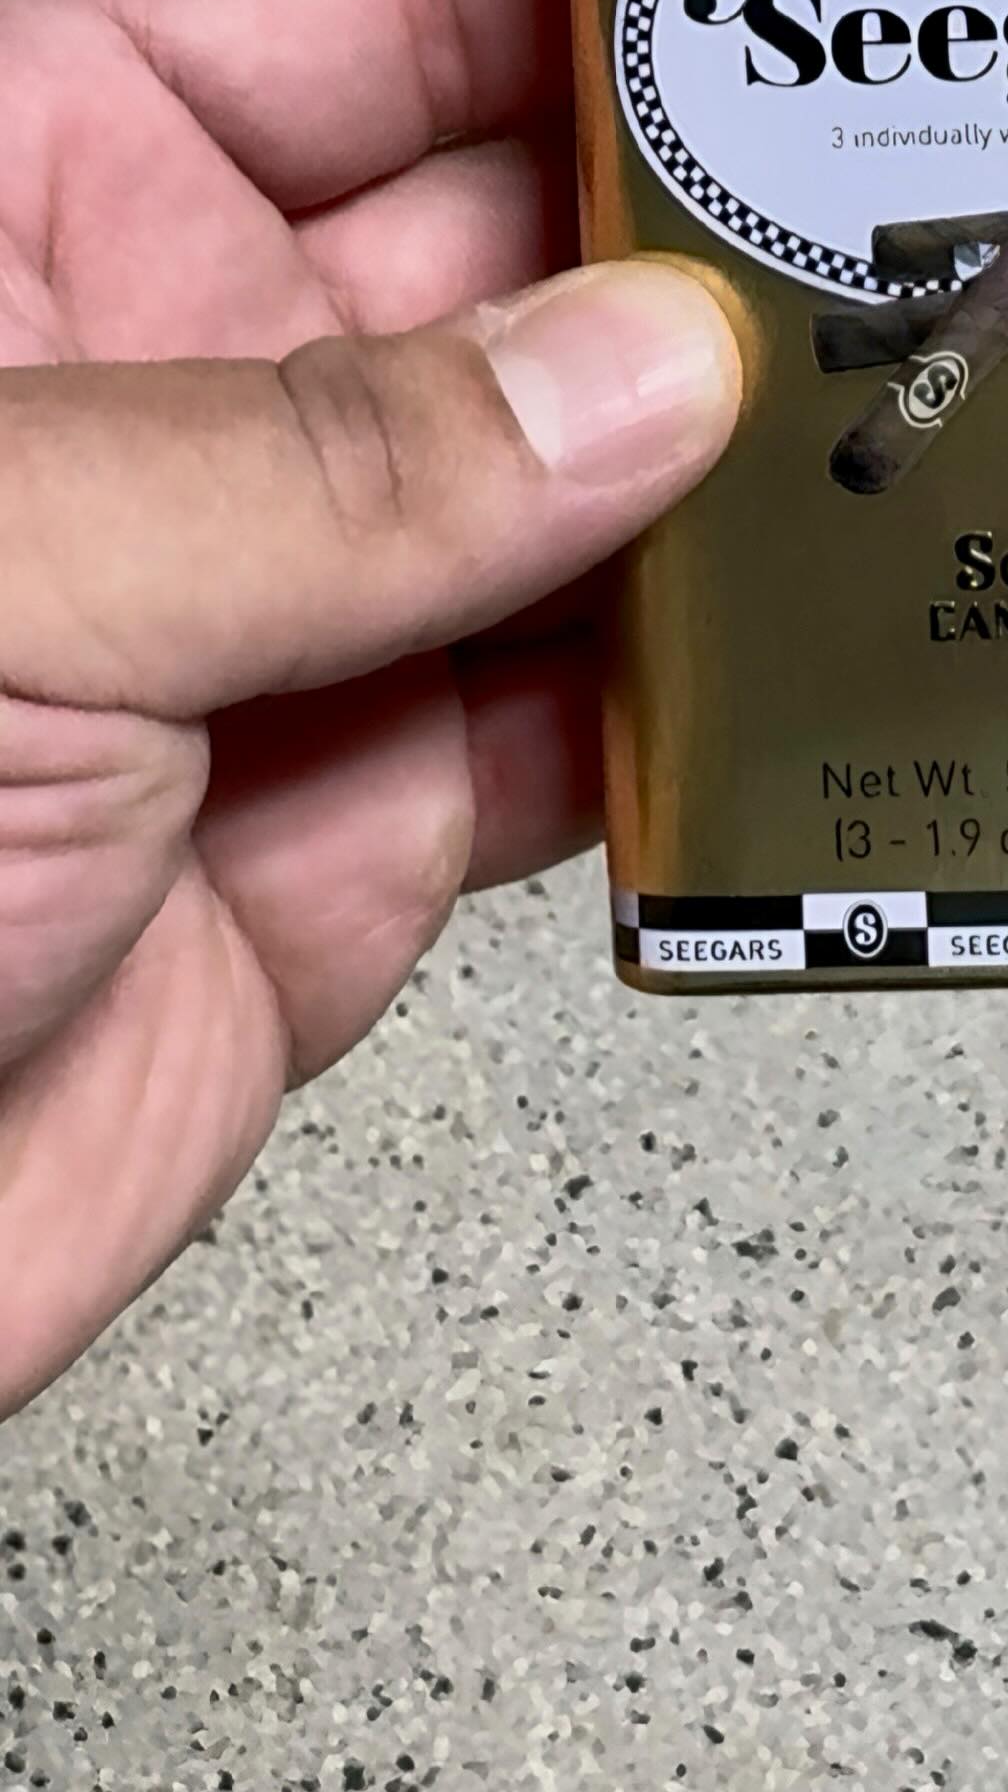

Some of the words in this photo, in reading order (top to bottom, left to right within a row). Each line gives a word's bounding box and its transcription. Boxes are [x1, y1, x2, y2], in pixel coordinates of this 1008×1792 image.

[832, 128, 844, 149] 3
[855, 122, 992, 150] individually
[821, 761, 899, 799] Net
[835, 817, 872, 862] (3
[926, 818, 982, 858] 1.9
[658, 938, 783, 962] SEEGARS
[854, 913, 876, 946] S
